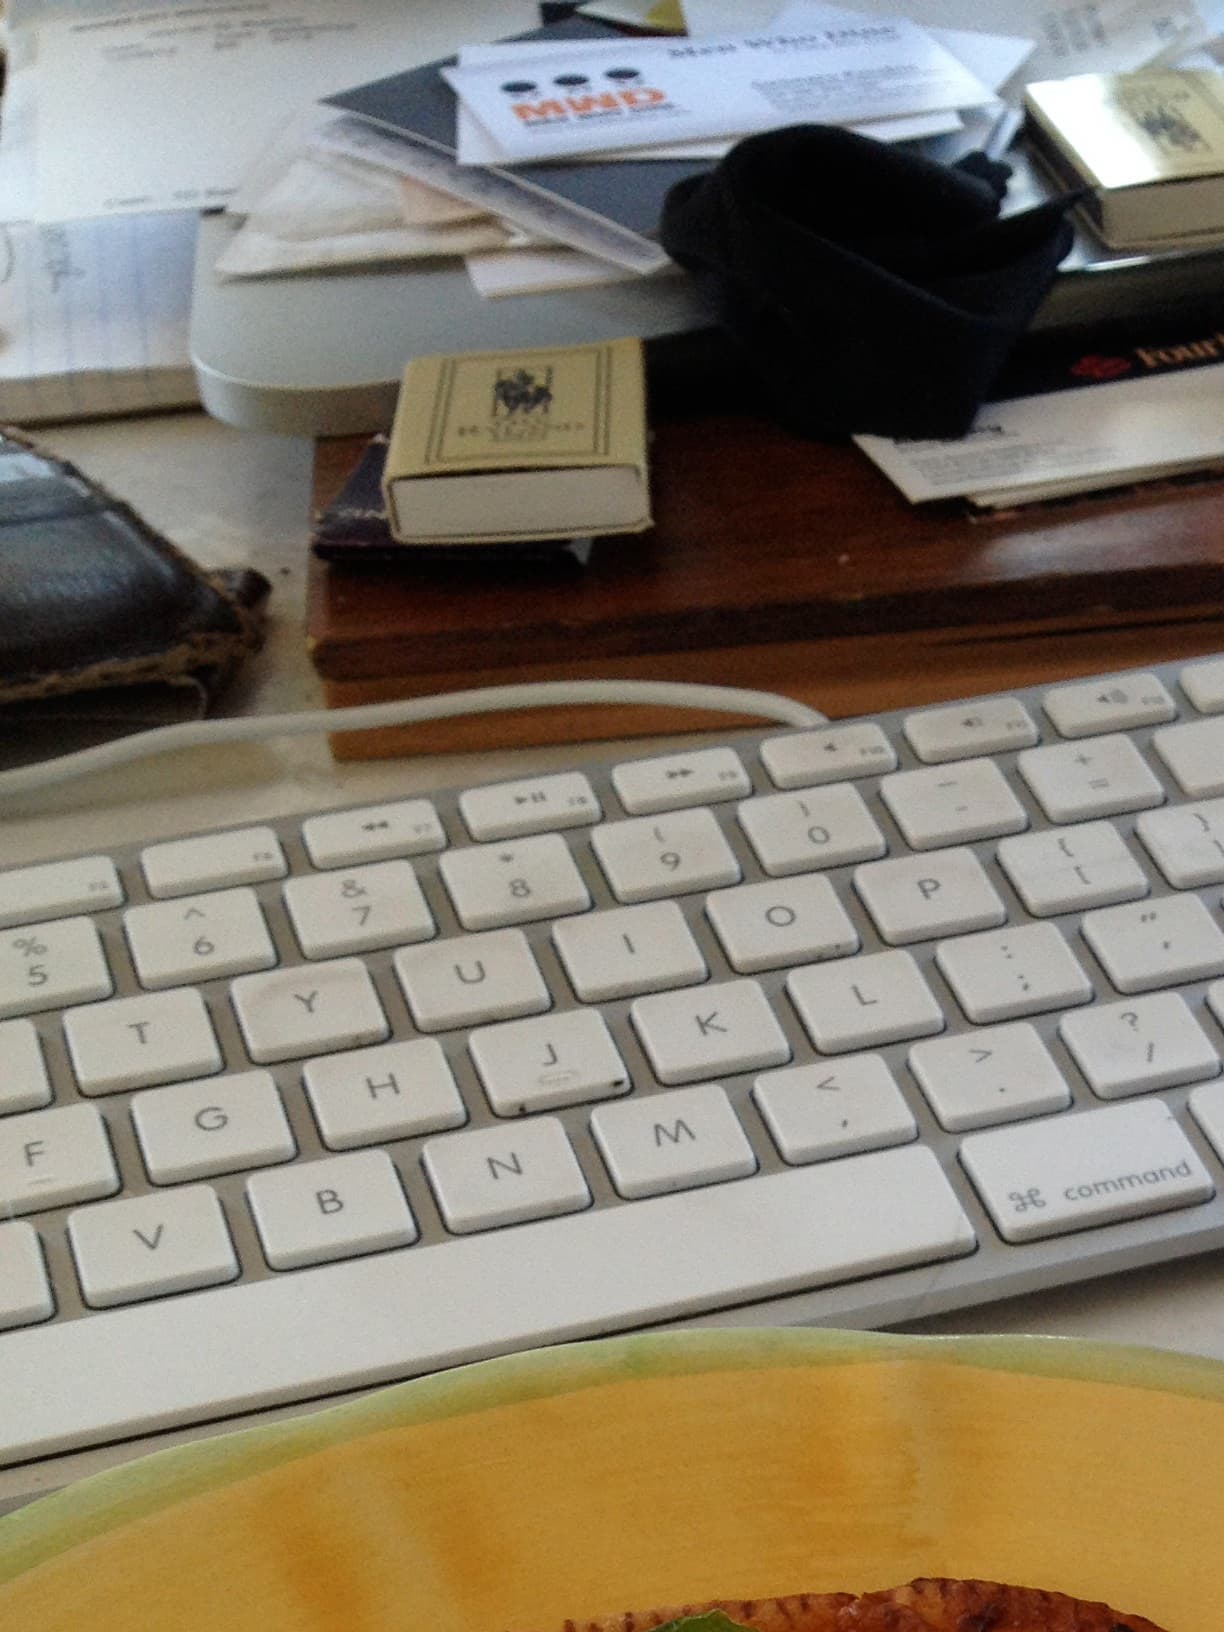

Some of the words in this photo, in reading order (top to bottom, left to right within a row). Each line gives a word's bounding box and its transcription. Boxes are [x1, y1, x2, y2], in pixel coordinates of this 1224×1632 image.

[511, 87, 668, 121] MWD
[660, 852, 681, 870] 9
[341, 879, 367, 899] &
[509, 879, 532, 899] 8
[916, 878, 941, 900] P
[352, 904, 372, 927] 7
[764, 905, 797, 928] O
[13, 935, 48, 957] %
[193, 936, 215, 956] 6
[28, 964, 49, 987] 5
[454, 960, 487, 985] U
[293, 990, 318, 1014] Y
[851, 985, 878, 1007] L
[128, 1021, 149, 1045] T
[695, 1011, 727, 1036] K
[544, 1043, 559, 1066] J
[365, 1073, 400, 1099] H
[194, 1106, 229, 1132] G
[653, 1119, 696, 1147] M
[23, 1140, 43, 1167] F
[486, 1152, 523, 1180] N
[1063, 1160, 1193, 1204] command
[315, 1189, 344, 1215] B
[132, 1224, 164, 1251] V
